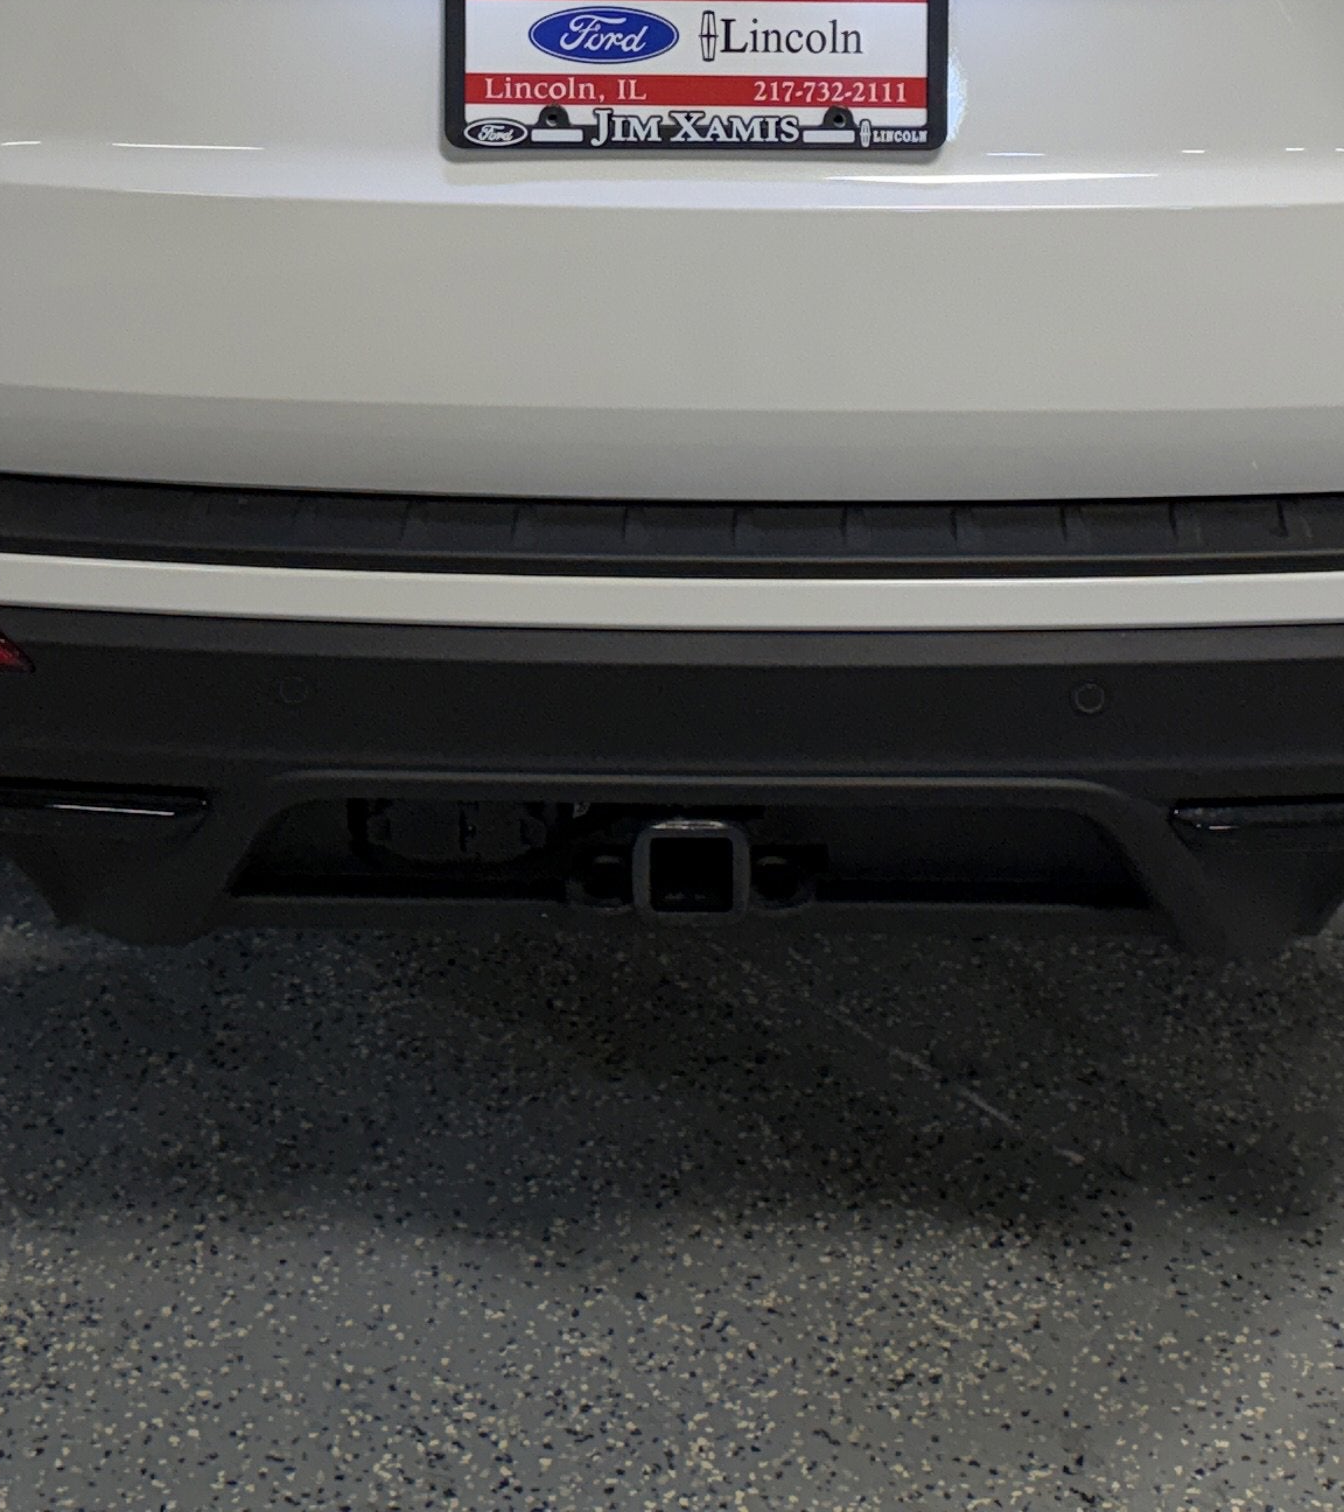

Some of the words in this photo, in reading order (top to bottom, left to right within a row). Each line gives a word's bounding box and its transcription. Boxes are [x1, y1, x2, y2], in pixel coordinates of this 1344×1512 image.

[559, 16, 648, 53] Ford
[720, 18, 864, 54] Lincoln
[485, 77, 605, 103] Lincoln,
[617, 79, 647, 100] IL
[754, 81, 907, 103] 217-732-2111
[591, 109, 662, 147] JIM
[670, 111, 799, 143] XAMIS
[873, 130, 927, 143] LINCOLN
